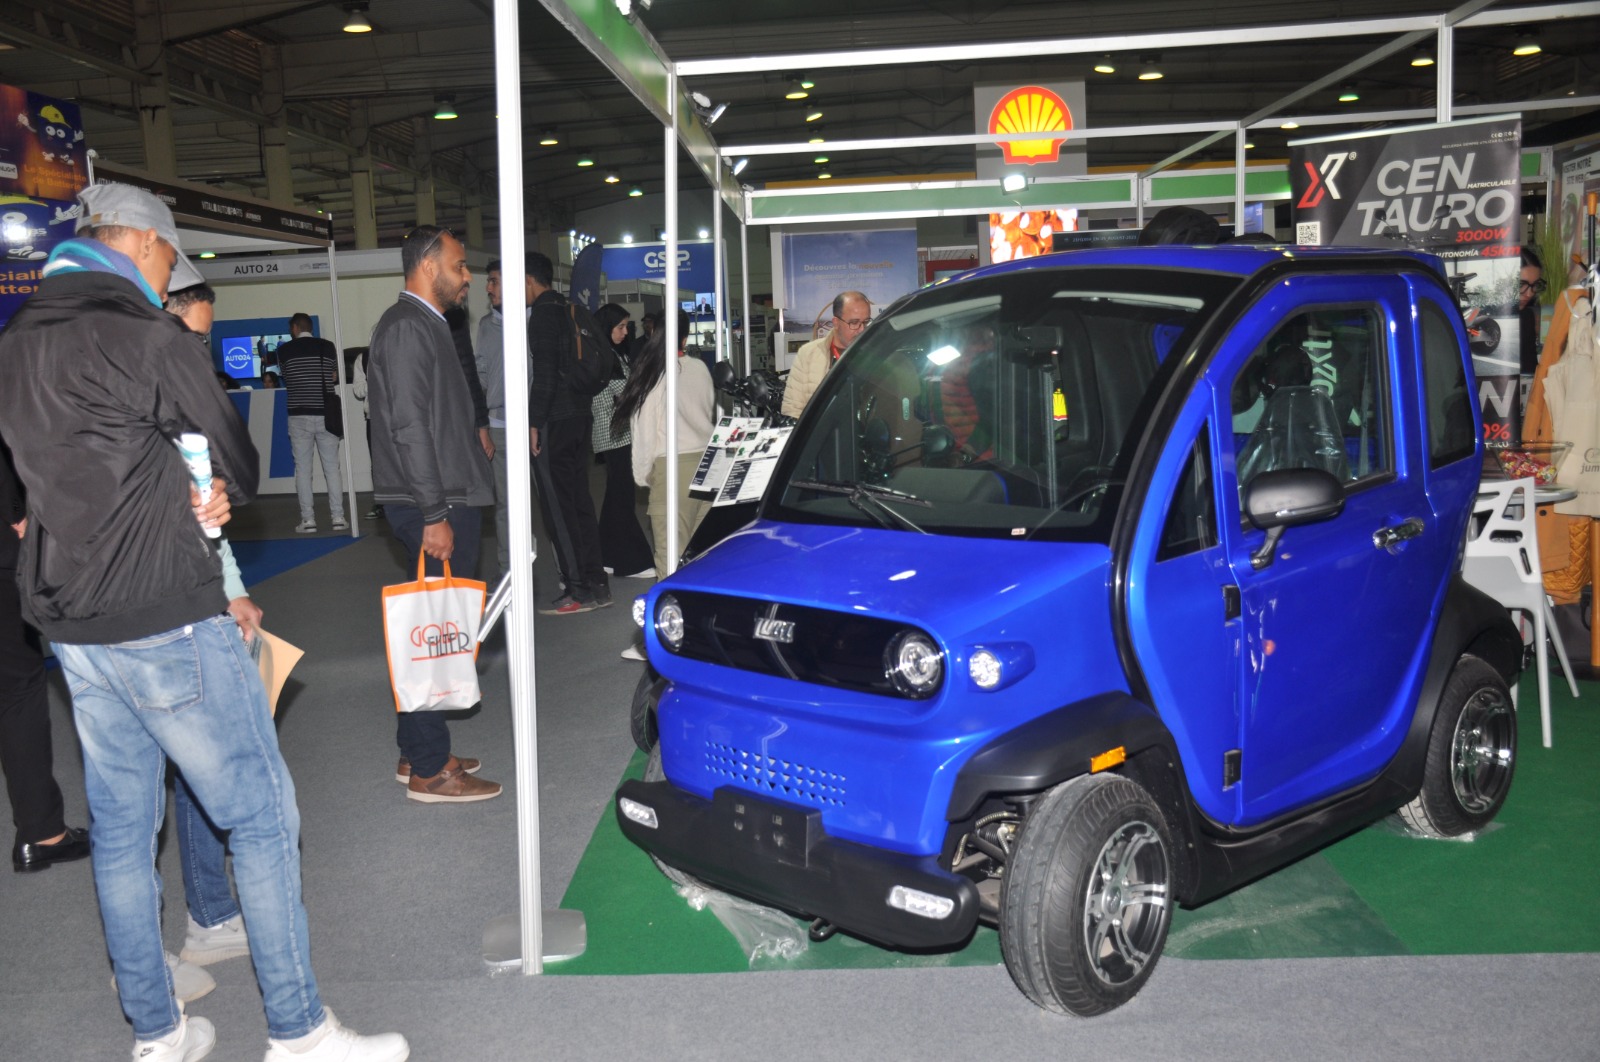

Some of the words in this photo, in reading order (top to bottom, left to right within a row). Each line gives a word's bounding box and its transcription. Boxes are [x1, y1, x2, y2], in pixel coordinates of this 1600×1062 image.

[1377, 153, 1475, 196] CEN
[1467, 179, 1516, 189] MATRICULABLE
[1357, 189, 1515, 235] TAURO
[1456, 228, 1510, 243] 3000W
[1480, 245, 1520, 257] 45km
[234, 265, 263, 274] AUTO
[266, 264, 278, 273] 24
[804, 264, 846, 272] Découvrez
[848, 262, 857, 270] la
[410, 621, 459, 647] GOLD
[428, 632, 472, 658] FILTER
